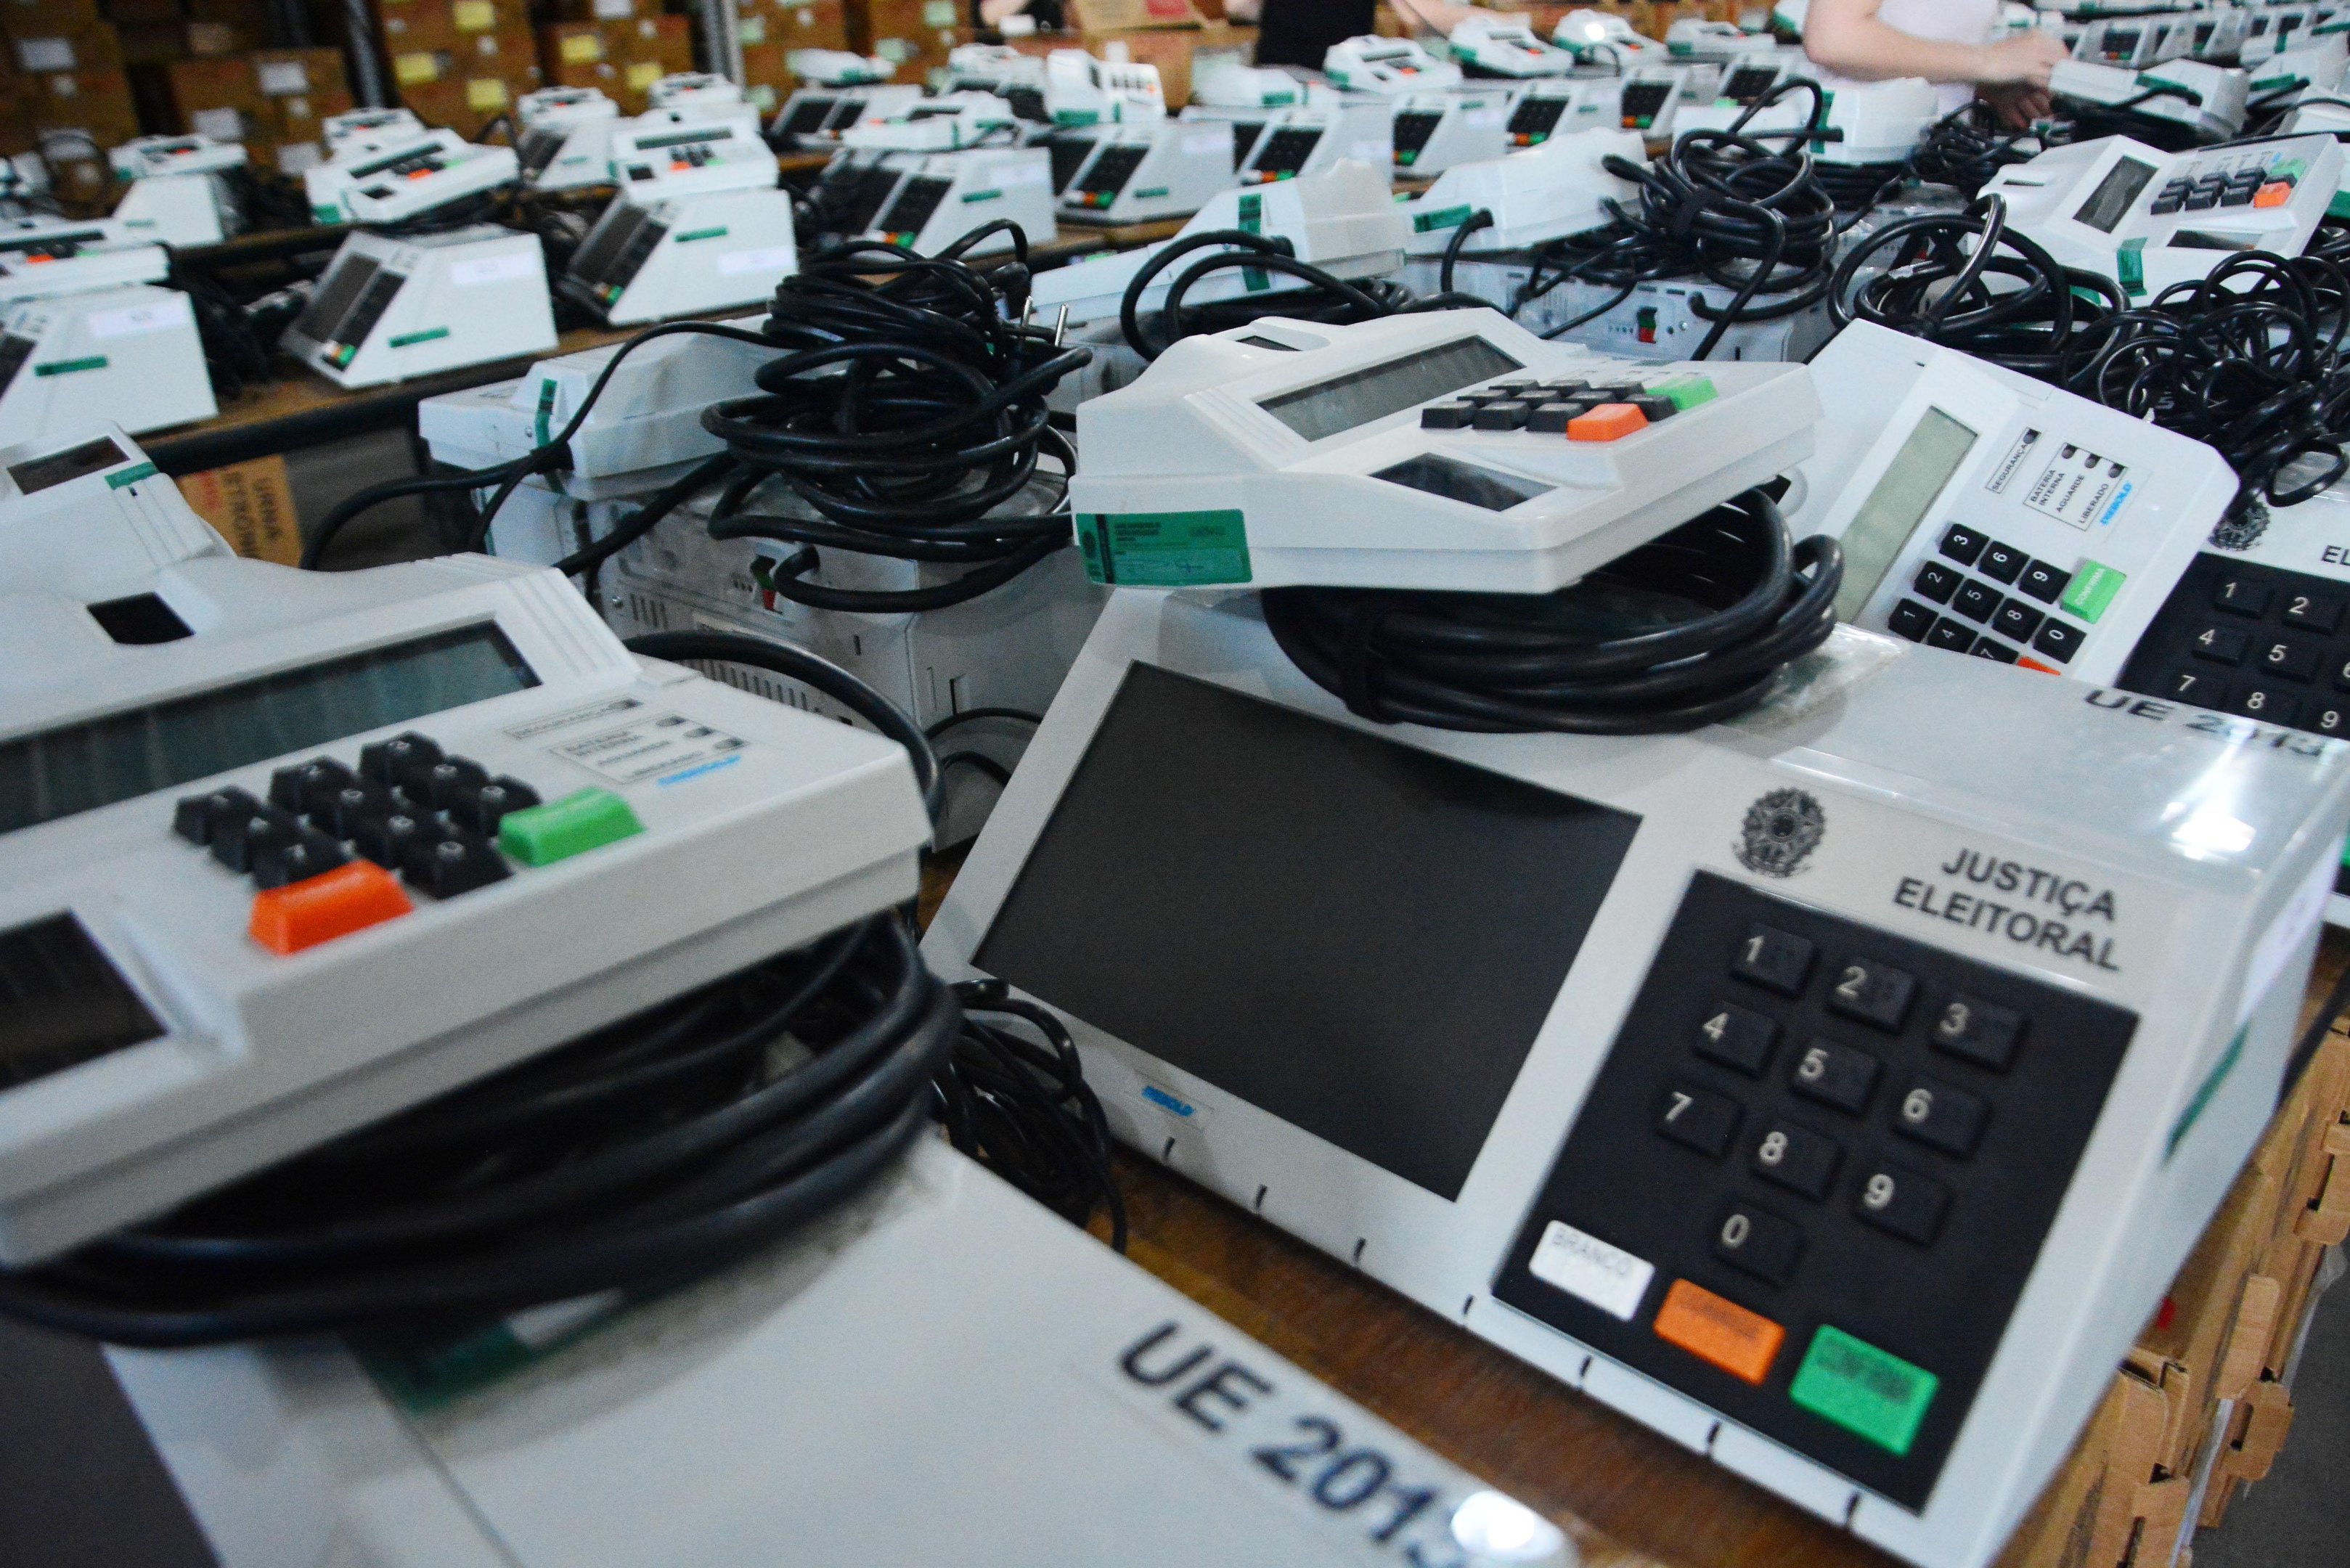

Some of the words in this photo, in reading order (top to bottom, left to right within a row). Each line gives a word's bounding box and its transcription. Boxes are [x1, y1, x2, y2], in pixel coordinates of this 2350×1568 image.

[1991, 442, 2030, 491] SEGURANÇA
[2030, 468, 2056, 502] BATERIA
[2039, 472, 2065, 506] INTERNA
[2055, 474, 2085, 513] AGUARDE
[2078, 483, 2109, 524] LIBERADO
[1927, 571, 1943, 583] 2
[1953, 534, 1969, 546] 3
[1941, 627, 1956, 640] 4
[1967, 589, 1983, 600] 5
[1992, 551, 2008, 563] 6
[2007, 609, 2023, 621] 8
[2032, 570, 2049, 582] 9
[2224, 581, 2237, 599] 1
[2288, 596, 2310, 614] 2
[2048, 629, 2065, 640] 0
[2198, 628, 2215, 645] 4
[2268, 644, 2288, 662] 5
[2084, 689, 2175, 721] UE
[2179, 674, 2196, 692] 7
[2247, 691, 2266, 710] 8
[2320, 710, 2340, 729] 9
[1941, 848, 2116, 921] JUSTIÇA
[1892, 875, 2121, 972] ELEITORAL
[1745, 935, 1765, 963] 1
[1835, 965, 1868, 998] 2
[1939, 1002, 1969, 1036] 3
[1701, 1011, 1729, 1041] 4
[1798, 1047, 1829, 1082] 5
[1901, 1087, 1933, 1123] 6
[1664, 1091, 1694, 1122] 7
[1758, 1130, 1789, 1165] 8
[1863, 1172, 1895, 1209] 9
[1721, 1213, 1750, 1248] 0
[1117, 1321, 1273, 1434] UE
